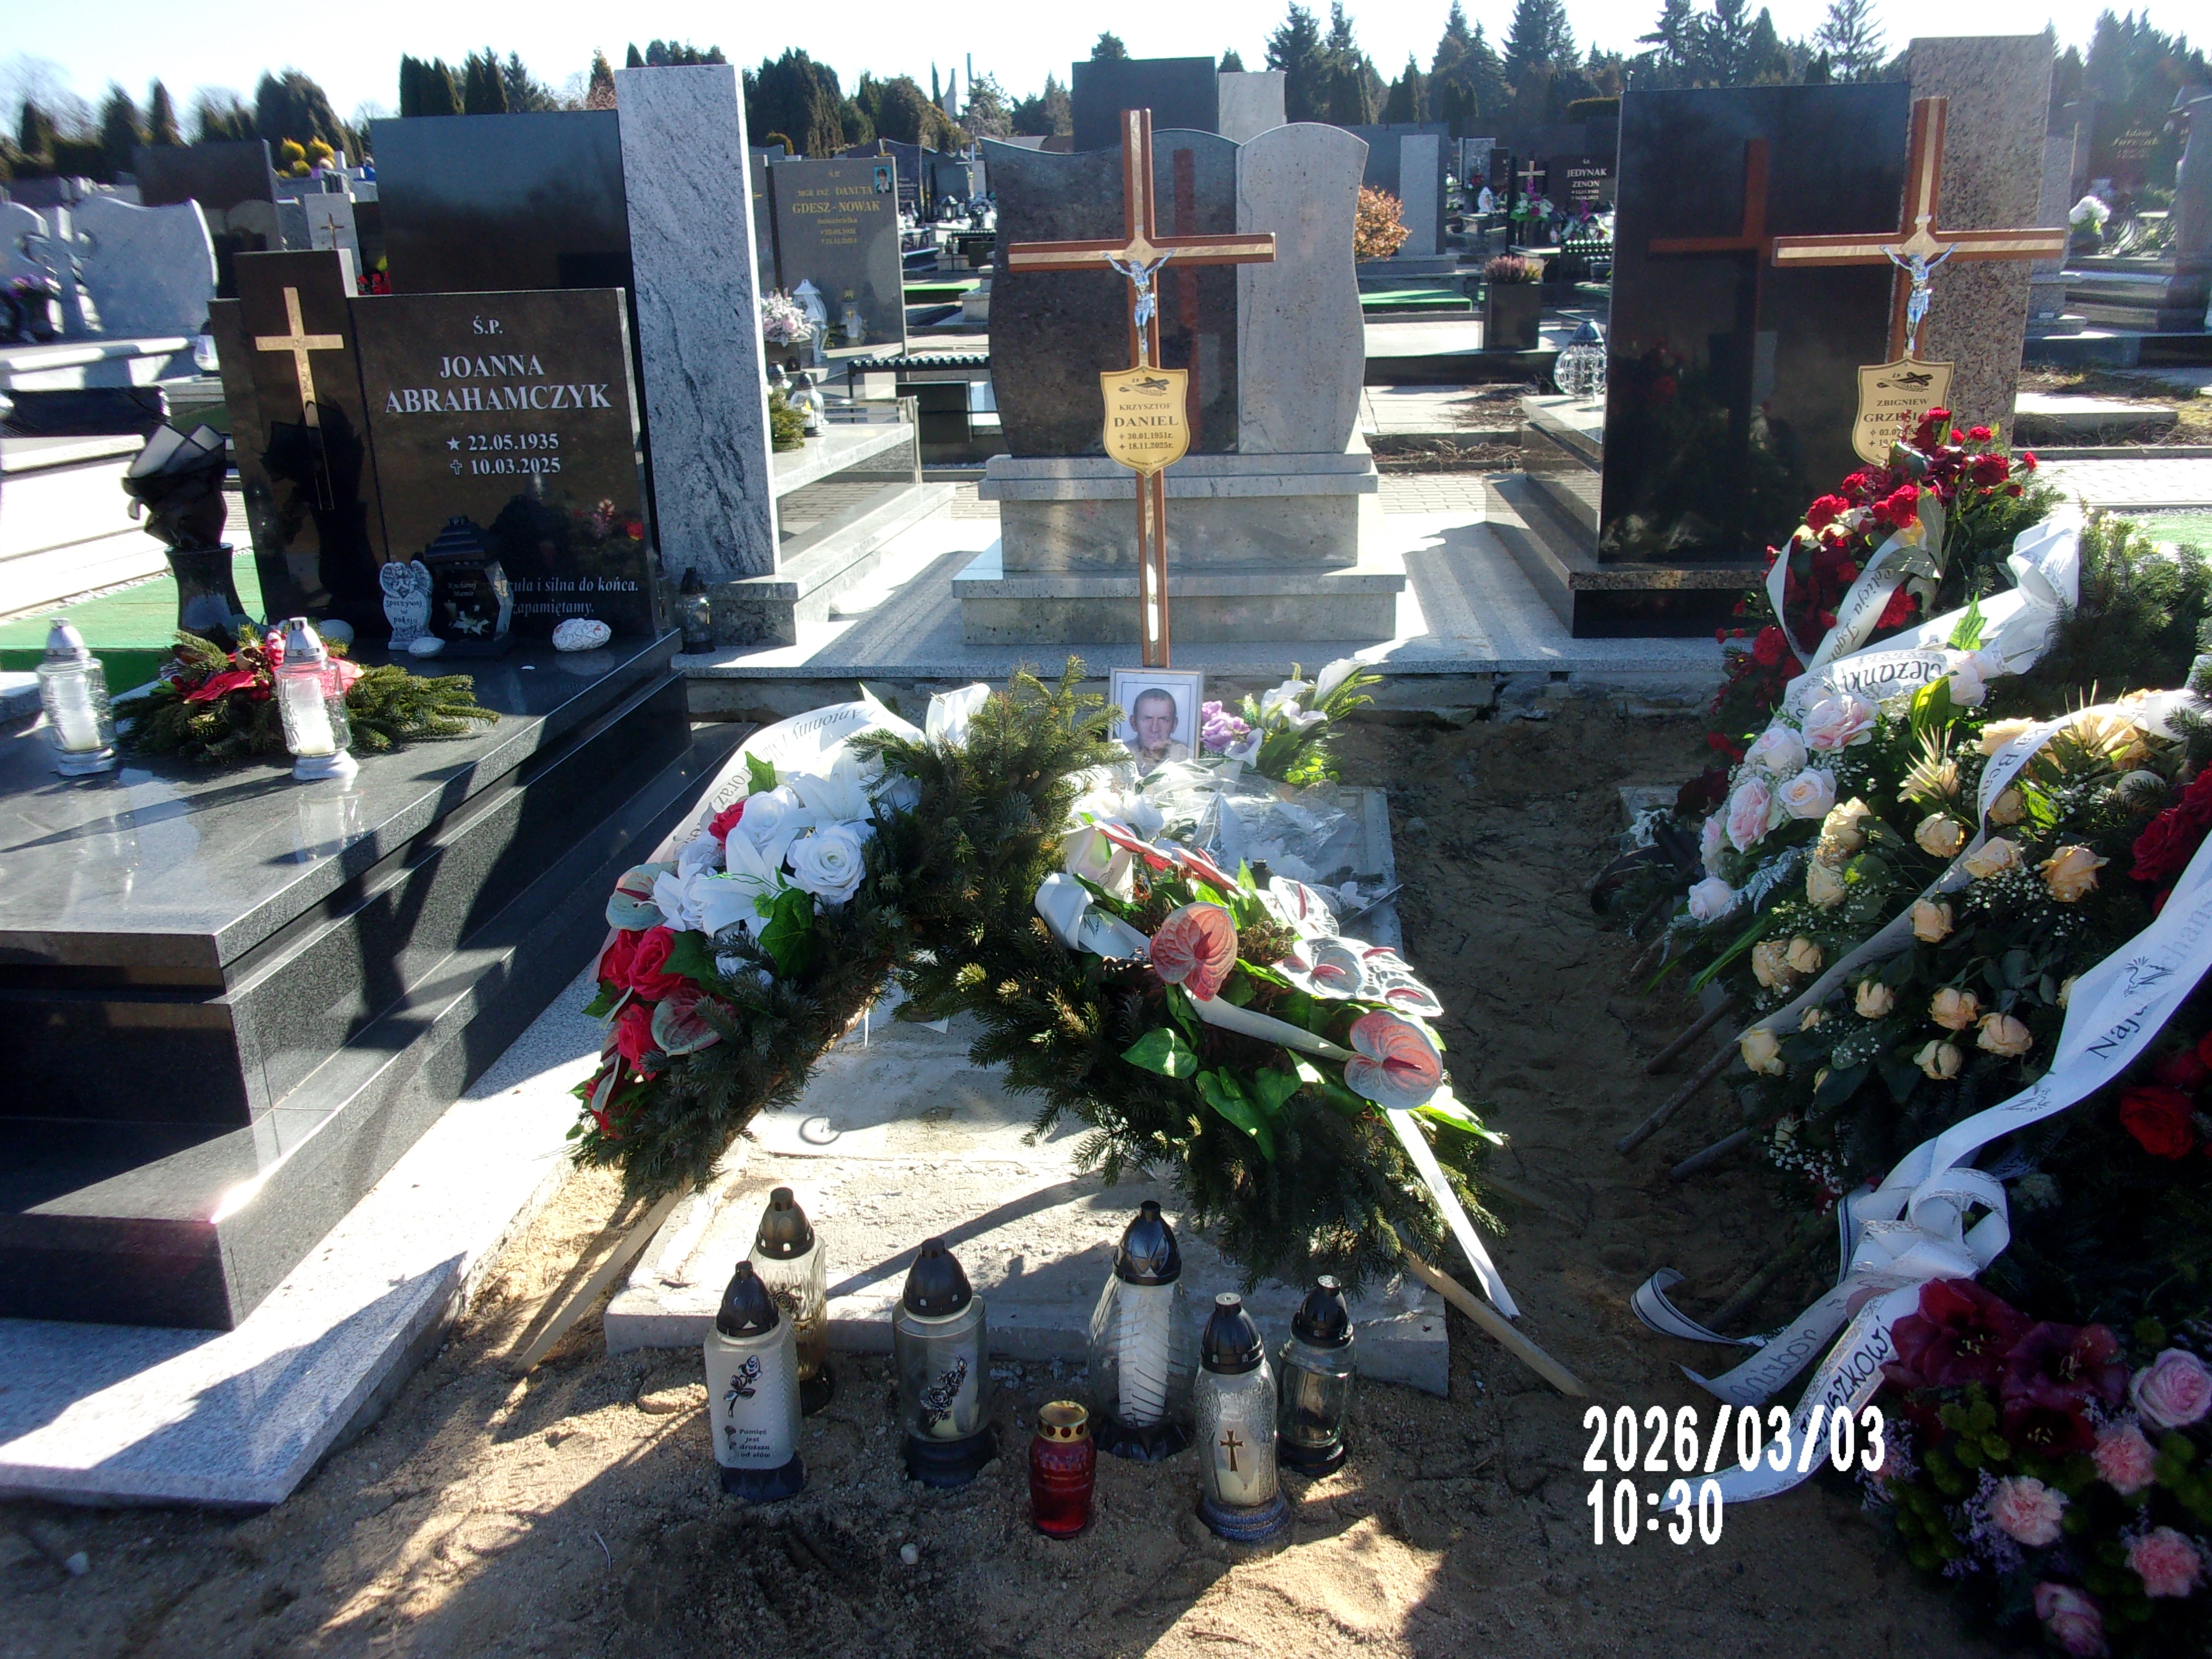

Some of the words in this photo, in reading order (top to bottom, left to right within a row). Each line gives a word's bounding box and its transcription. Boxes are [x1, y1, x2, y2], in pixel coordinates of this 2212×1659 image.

[1567, 168, 1607, 179] JEDYNAK
[835, 186, 873, 195] DANUTA
[793, 202, 830, 214] GDESZ
[838, 201, 881, 212] NOWAK
[472, 315, 504, 335] Ś.P.
[440, 354, 545, 379] JOANNA
[385, 384, 612, 413] ABRAHAMCZYK
[1876, 398, 1929, 407] ZBIGNIEW
[1114, 416, 1179, 427] DANIEL
[468, 433, 559, 451] 22.05.1935
[471, 457, 561, 475] 10.03.2025
[545, 577, 575, 592] silna
[579, 577, 594, 591] do
[793, 709, 866, 740] Antoniny
[713, 775, 745, 806] oraz
